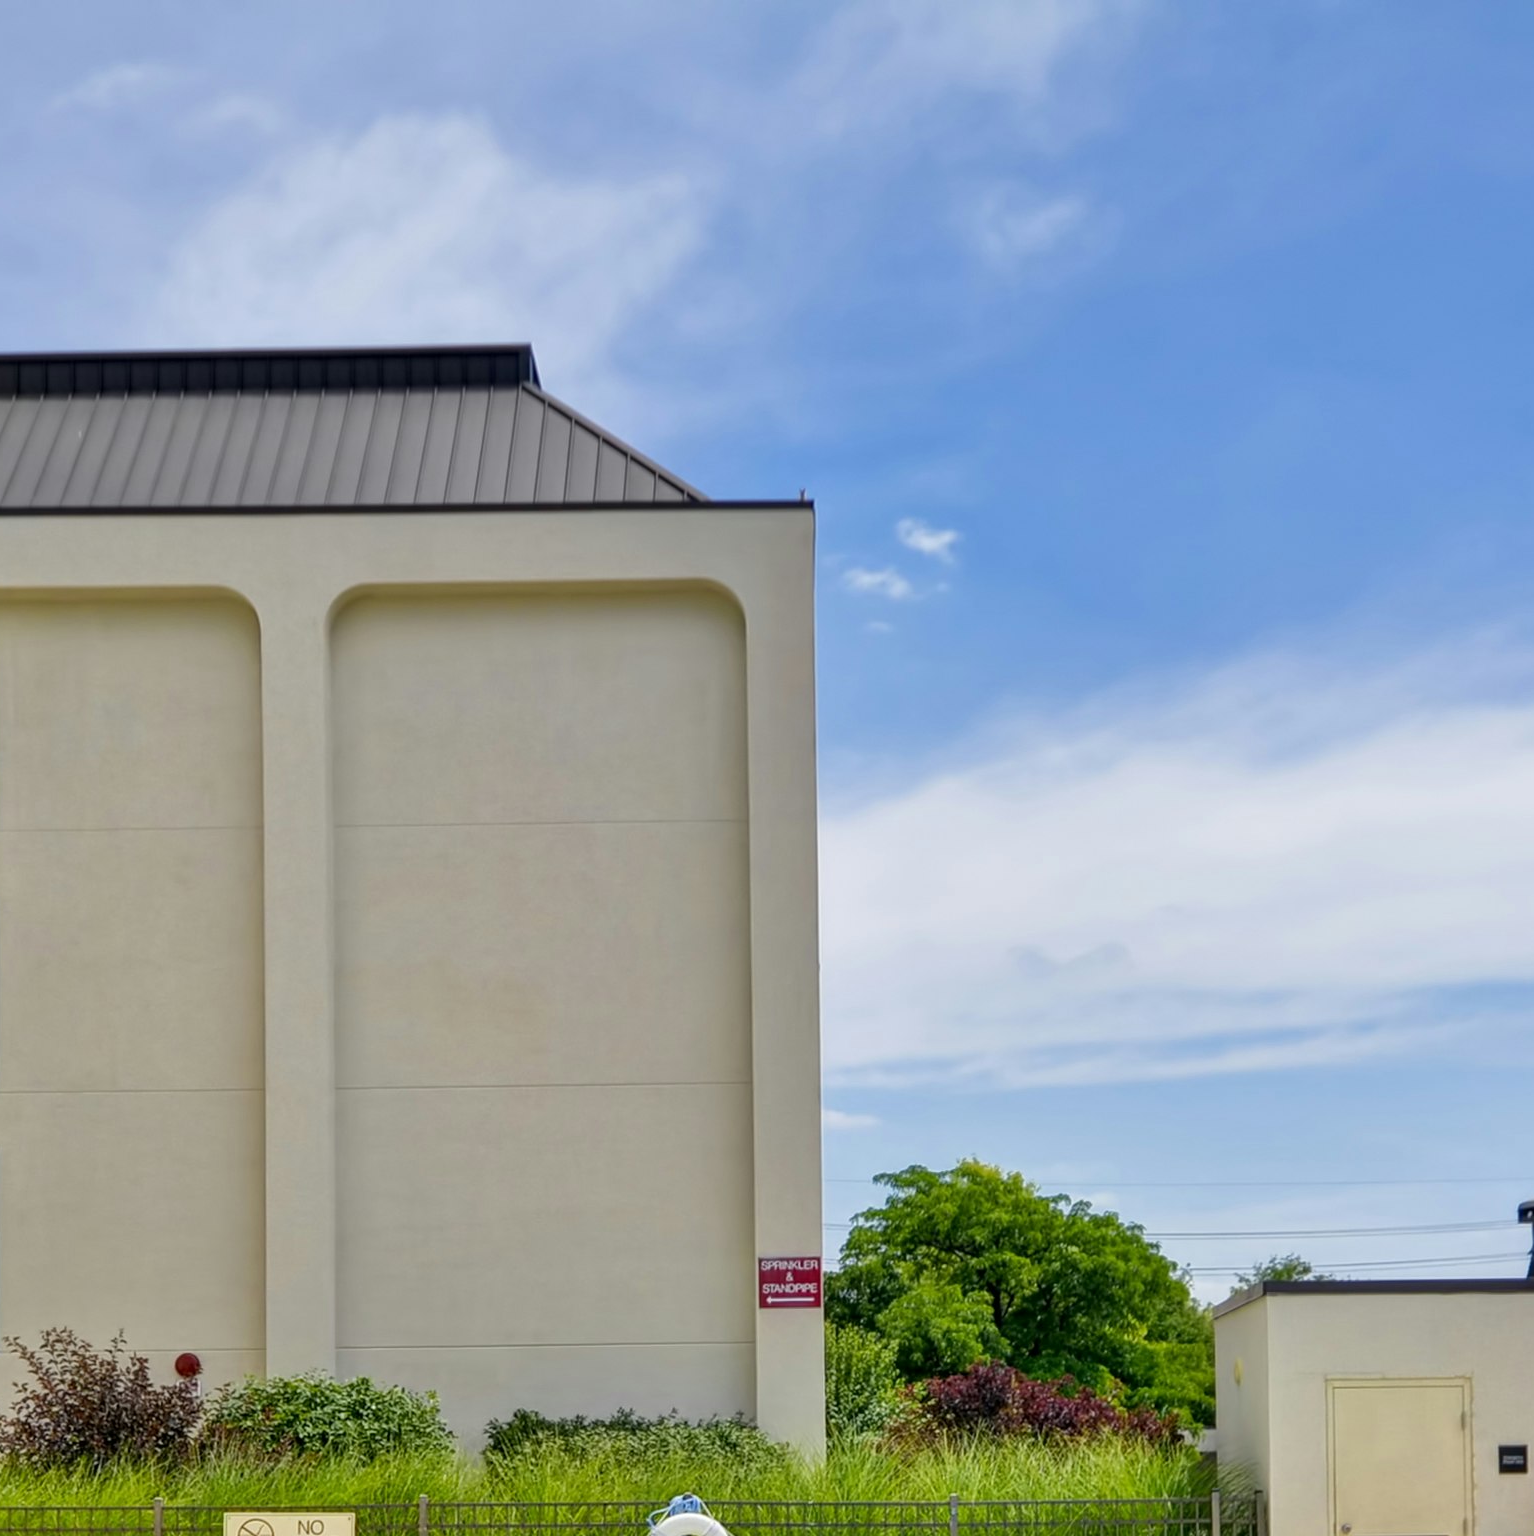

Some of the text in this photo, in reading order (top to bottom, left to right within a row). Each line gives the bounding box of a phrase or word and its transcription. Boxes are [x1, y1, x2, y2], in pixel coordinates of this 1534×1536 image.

[761, 1260, 818, 1271] SPRINKLER
[786, 1271, 794, 1281] &
[762, 1283, 818, 1294] STANDPIPE
[297, 1520, 325, 1536] NO
